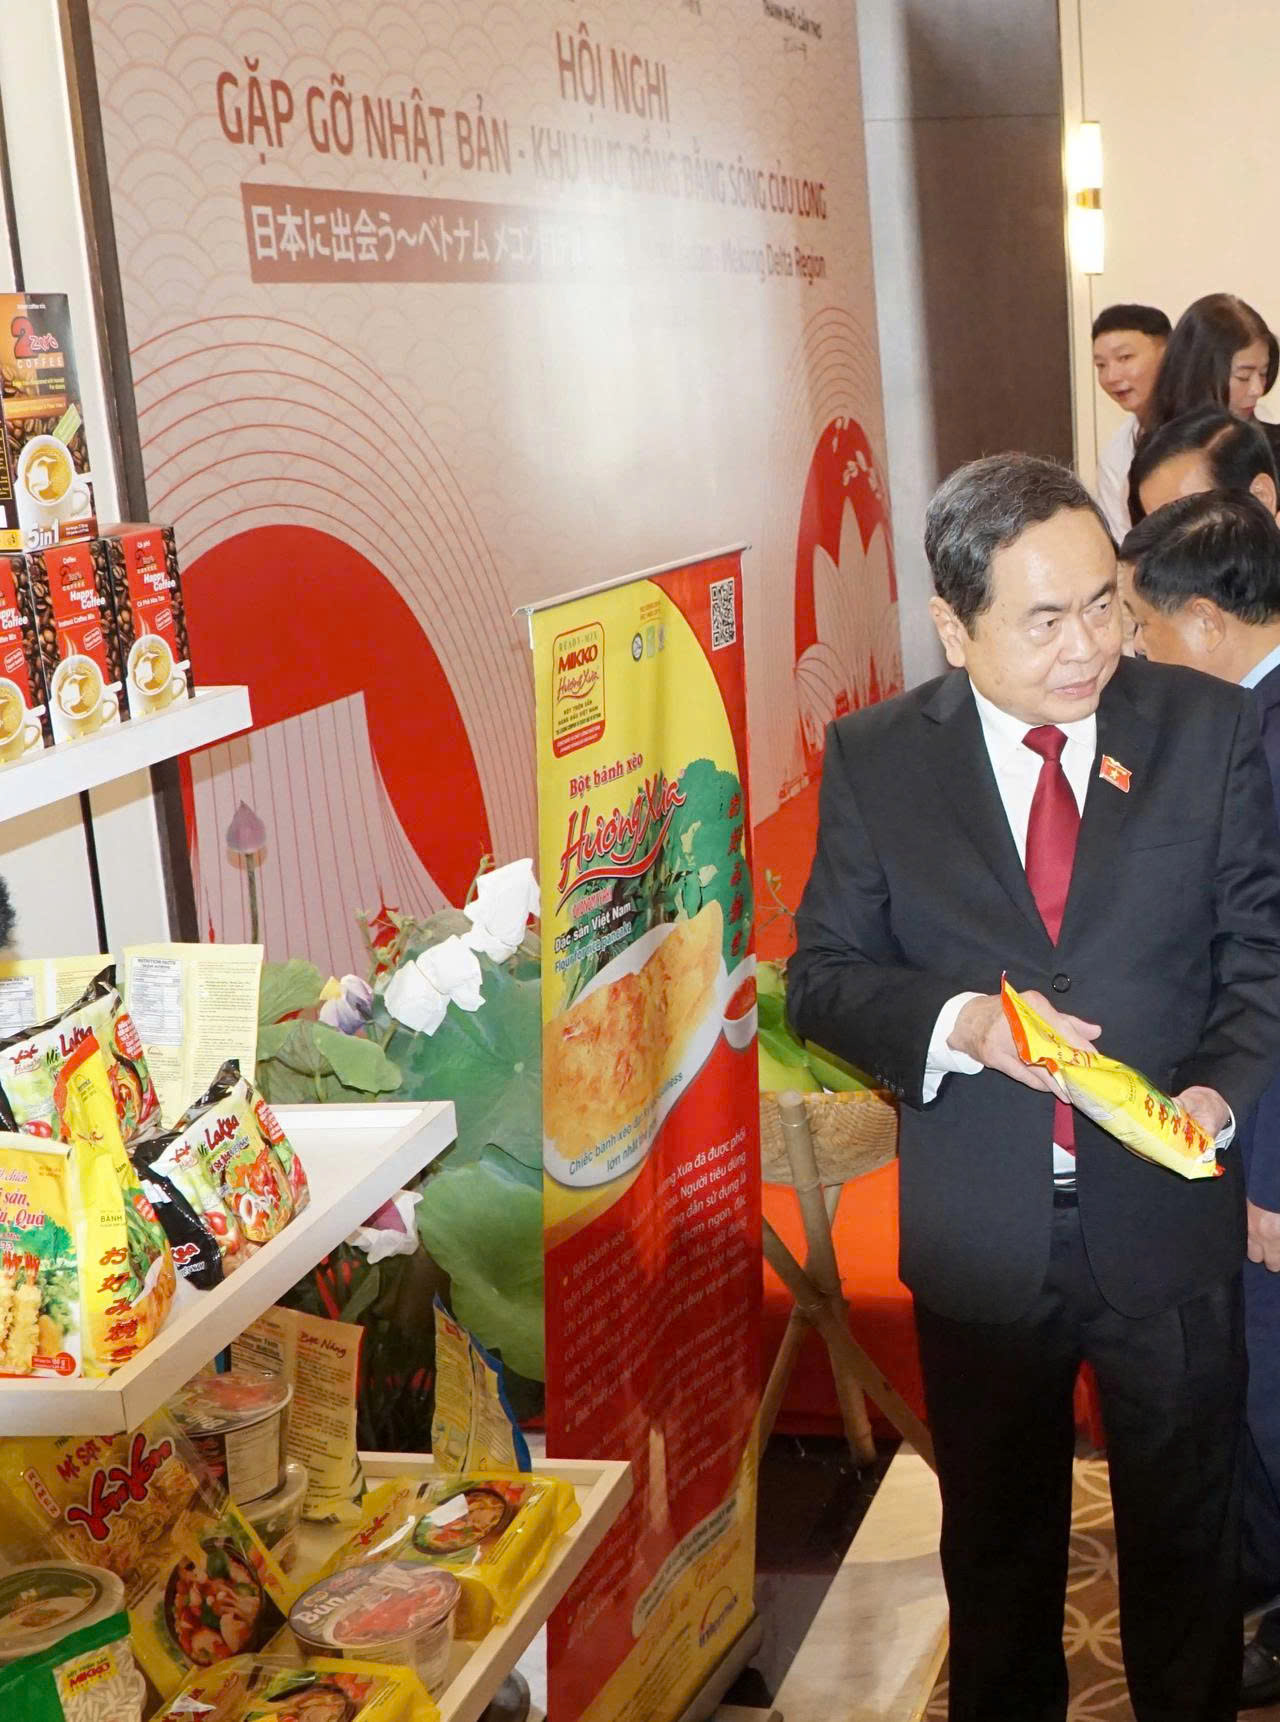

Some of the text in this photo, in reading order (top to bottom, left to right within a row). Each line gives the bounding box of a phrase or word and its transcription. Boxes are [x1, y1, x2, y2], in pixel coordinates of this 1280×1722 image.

[556, 21, 671, 138] HỘI NGHỊ
[216, 56, 295, 165] GẶP
[306, 72, 354, 156] GỠ
[361, 87, 446, 181] NHẬT
[455, 93, 512, 175] BẢN
[729, 154, 767, 211] SÔNG
[767, 159, 795, 215] CỬU
[796, 177, 827, 221] LONG
[794, 245, 827, 286] Region
[17, 354, 65, 369] COFFEE
[143, 571, 166, 584] Happy
[153, 578, 176, 591] Coffee
[70, 588, 95, 602] Happy
[81, 597, 106, 610] Coffee
[2, 616, 29, 629] Coffee
[74, 614, 87, 624] Coffee
[558, 643, 598, 674] MIKKO
[569, 751, 644, 799] Bột bánh xèo
[554, 932, 572, 953] Đặc
[572, 923, 590, 941] sản
[591, 911, 611, 931] Việt
[612, 902, 632, 919] Nam
[694, 1151, 708, 1171] đã
[680, 1174, 708, 1202] Người
[708, 1164, 727, 1186] tiêu
[15, 1208, 45, 1230] Quả
